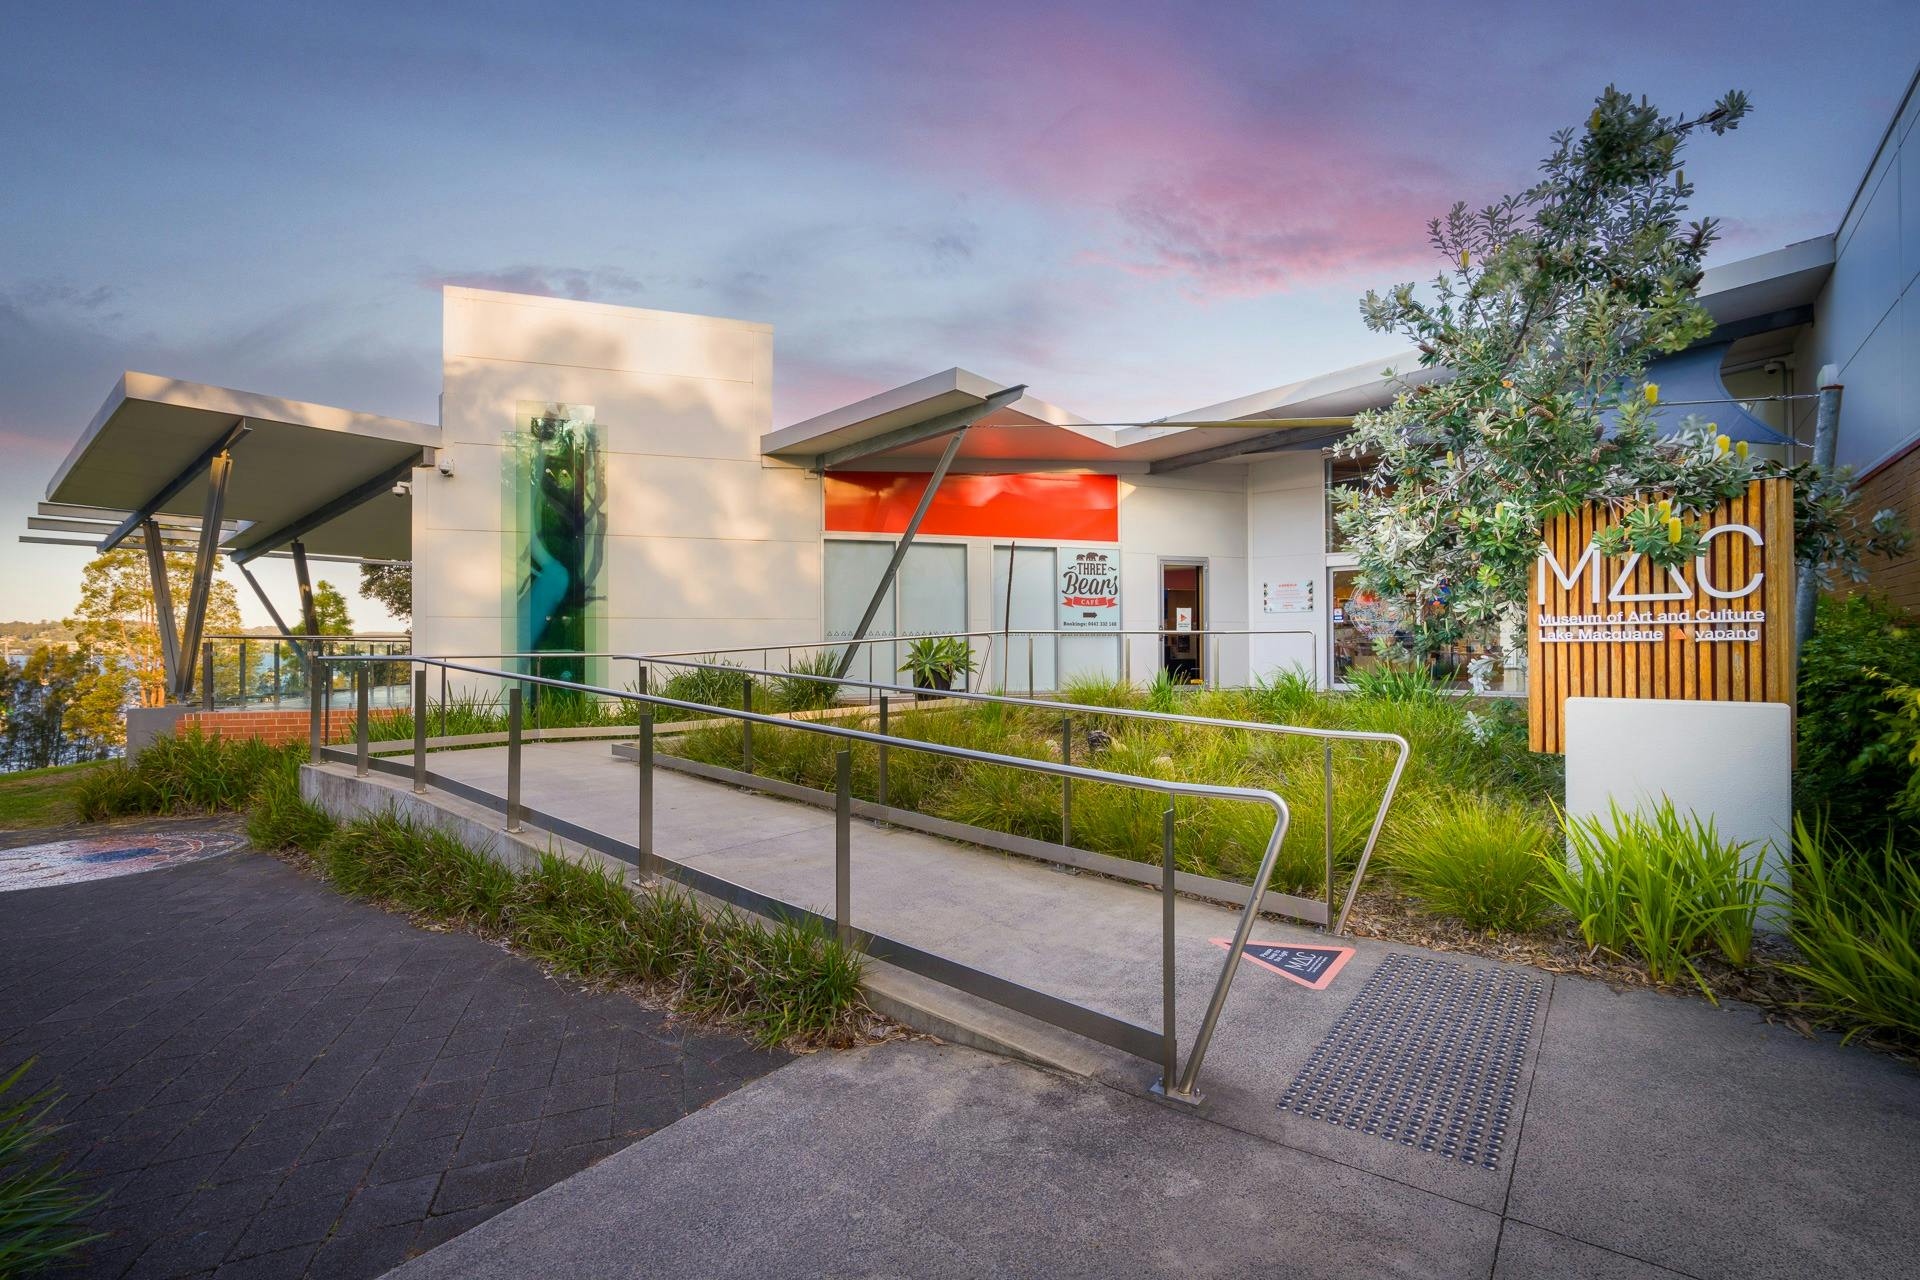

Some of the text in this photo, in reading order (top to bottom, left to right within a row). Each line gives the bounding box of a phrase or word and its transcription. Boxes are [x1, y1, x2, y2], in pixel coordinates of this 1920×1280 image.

[1077, 562, 1107, 575] THREE
[1061, 571, 1118, 595] Bears
[1538, 608, 1765, 625] Museum of Art and Culture
[1538, 628, 1759, 642] Lake Macquarie yapang
